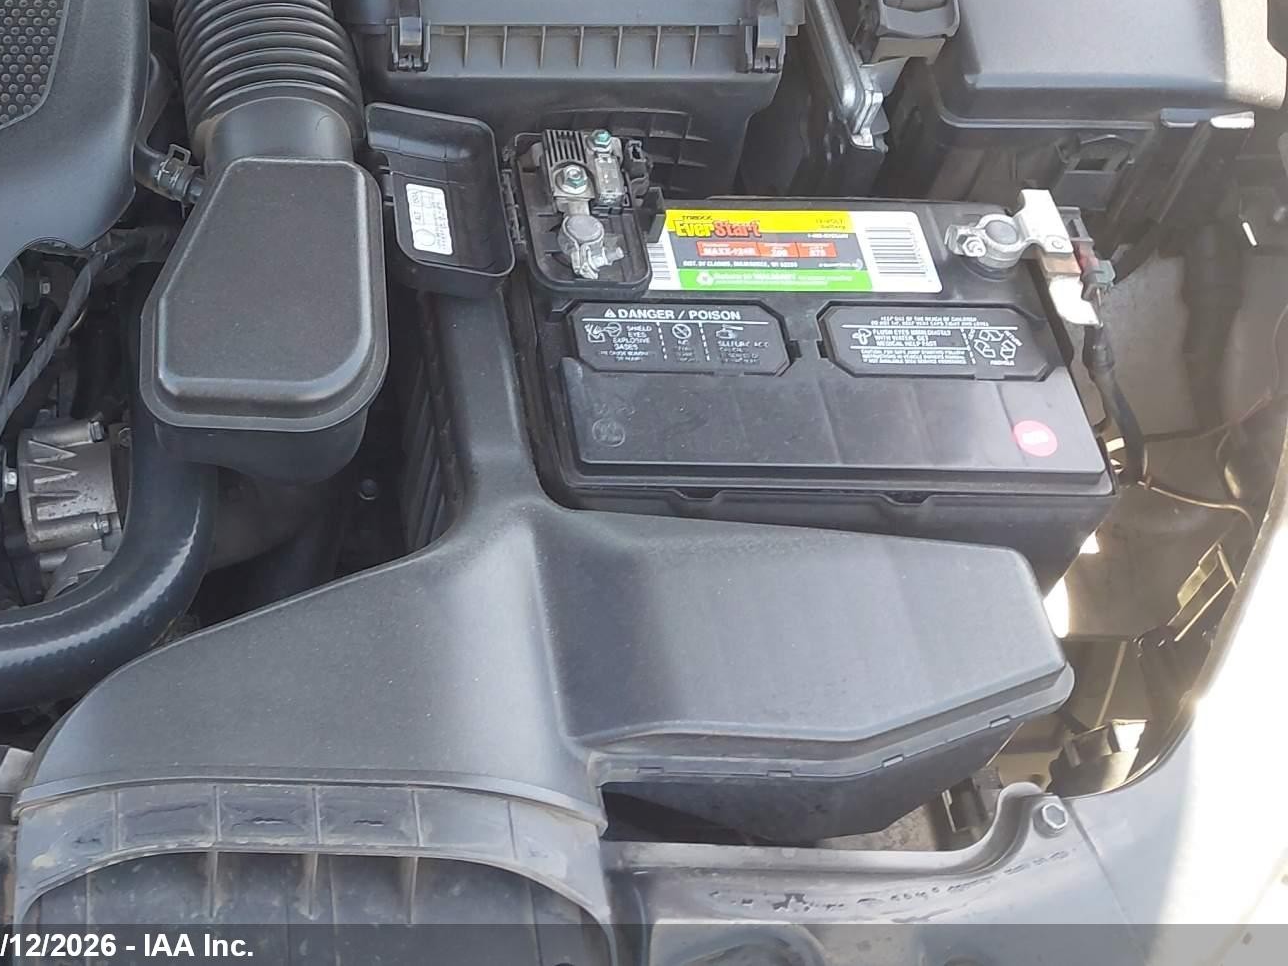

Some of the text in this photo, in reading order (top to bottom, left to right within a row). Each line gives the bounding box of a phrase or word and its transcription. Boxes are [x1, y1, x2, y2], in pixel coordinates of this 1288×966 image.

[674, 219, 762, 238] EverStart
[617, 308, 675, 320] DANGER
[689, 309, 741, 321] POISON
